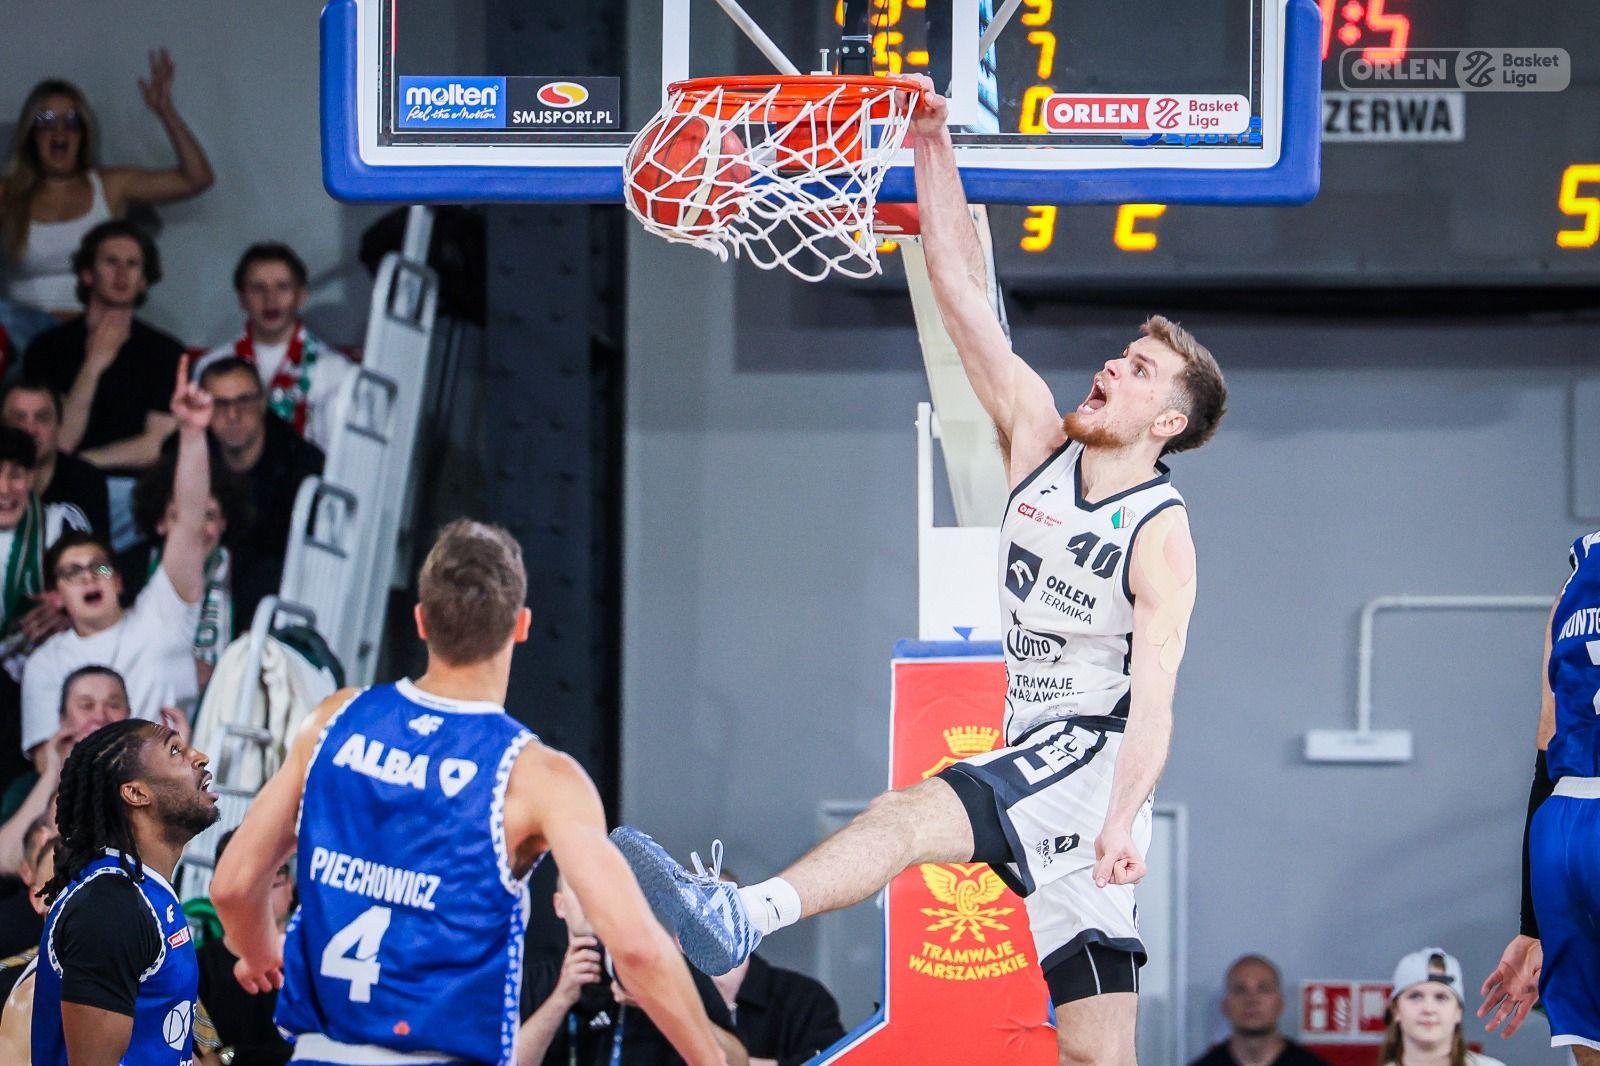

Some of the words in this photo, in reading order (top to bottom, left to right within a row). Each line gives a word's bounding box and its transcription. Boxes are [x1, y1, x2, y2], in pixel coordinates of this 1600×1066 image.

[406, 83, 497, 106] molten
[1188, 99, 1239, 112] Basket
[512, 110, 613, 124] SMJSPORT.PL
[1053, 102, 1139, 124] ORLEN
[1188, 114, 1219, 129] Liga
[1325, 98, 1454, 133] ZERWA
[1066, 531, 1122, 580] 40
[1046, 575, 1097, 610] ORLEN
[1039, 590, 1093, 625] TERMIKA
[1015, 629, 1051, 658] LOTTO
[332, 733, 430, 791] ALBA
[309, 846, 441, 911] PIECHOWICZ
[320, 904, 392, 1004] 4
[921, 940, 1015, 964] TRAMWAJE
[908, 953, 1029, 981] WARSZAWSKIE
